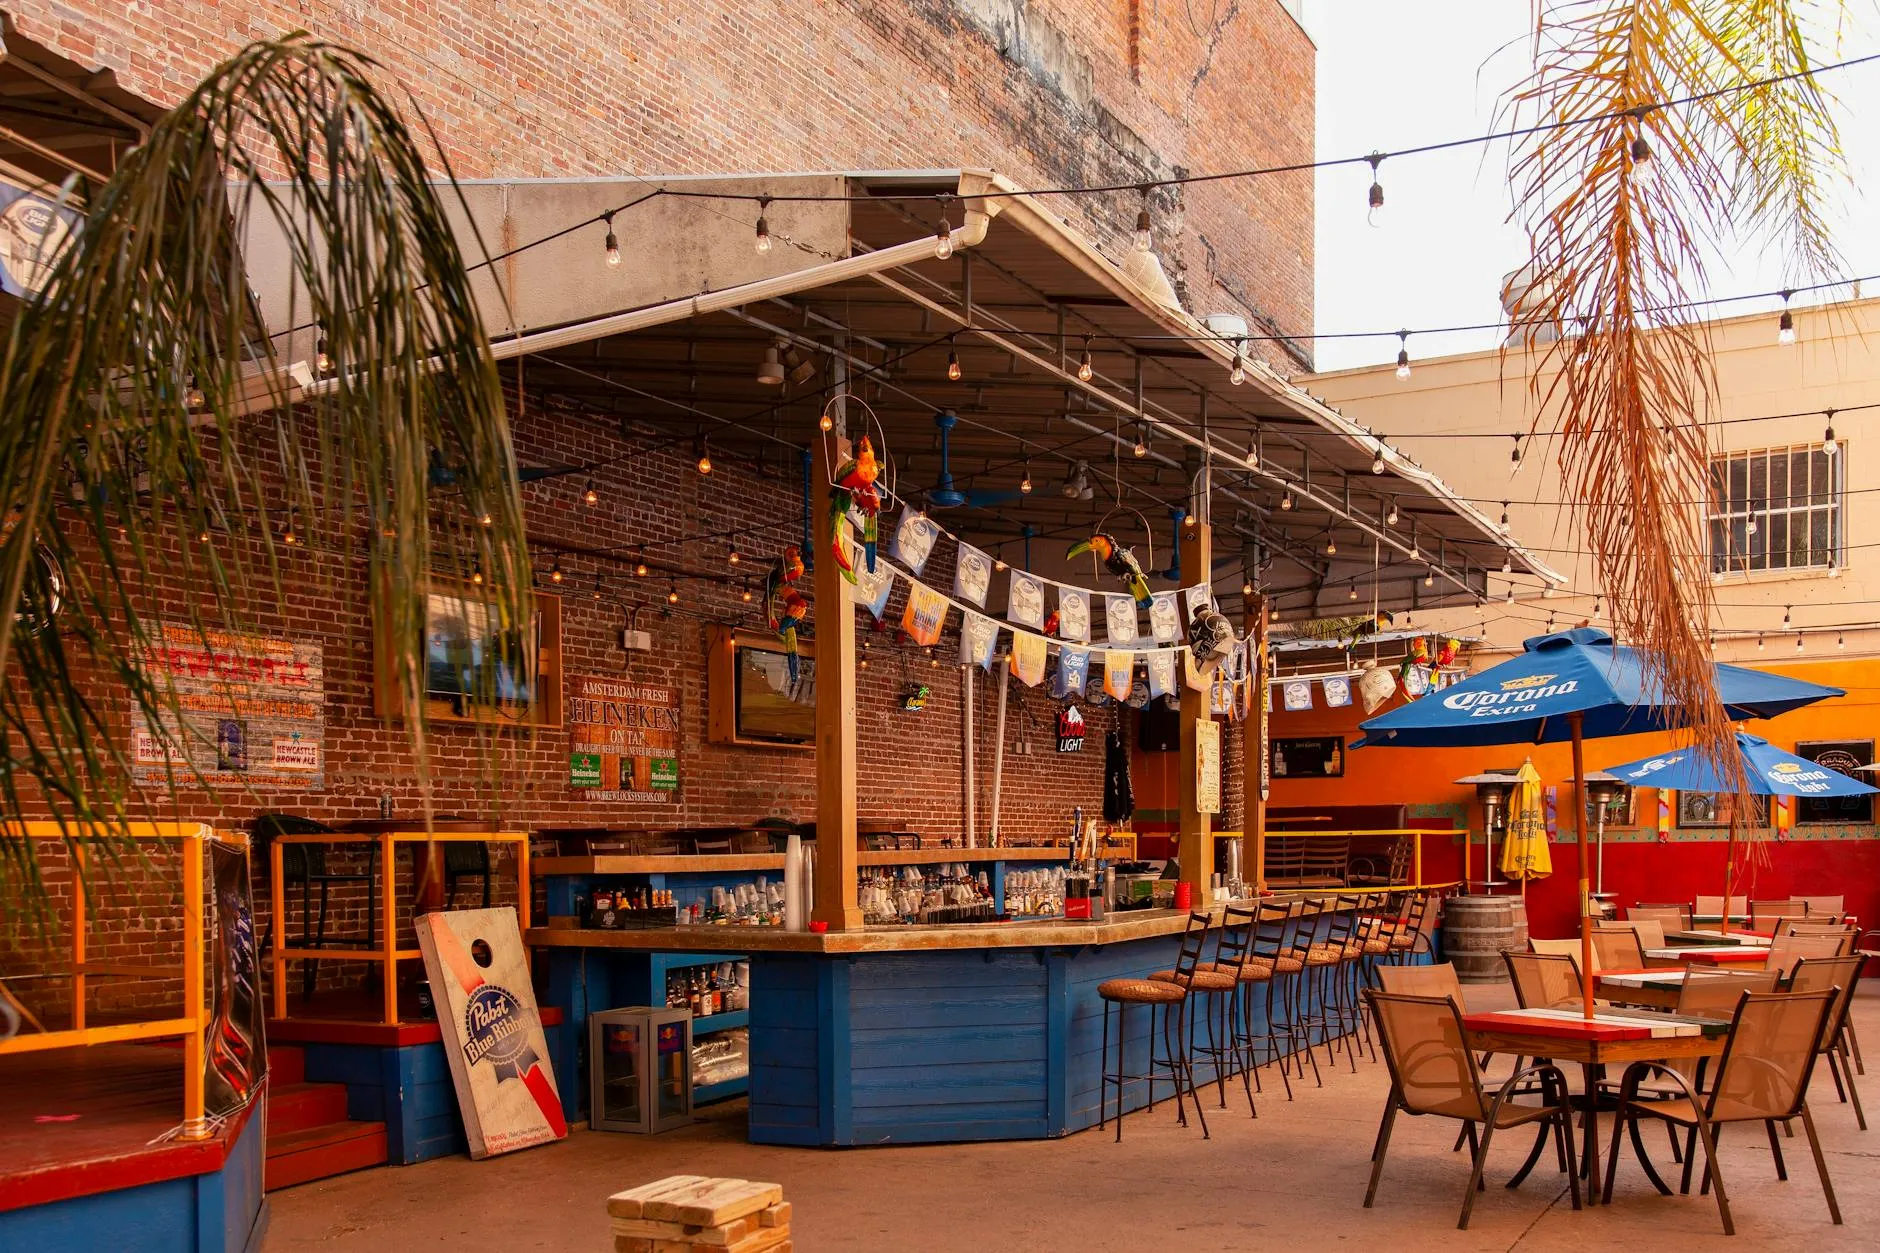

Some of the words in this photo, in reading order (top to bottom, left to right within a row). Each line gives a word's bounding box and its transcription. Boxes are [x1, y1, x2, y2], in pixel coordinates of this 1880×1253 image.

[582, 682, 640, 700] AMSTERDAM
[642, 688, 669, 703] FRESH
[1443, 680, 1578, 710] Corona
[570, 697, 680, 732] HEINEKEN
[1470, 704, 1537, 717] Extra
[610, 729, 625, 744] ON
[627, 731, 645, 746] TAP
[276, 745, 316, 756] NEWCASTLE
[1060, 738, 1084, 752] LIGHT
[140, 749, 167, 758] BROW
[572, 768, 600, 777] Heineken
[651, 772, 676, 781] Heineken
[1768, 771, 1831, 785] Corona
[469, 995, 509, 1032] Pabst
[465, 1034, 496, 1063] Blue
[490, 1014, 536, 1042] Ribbon
